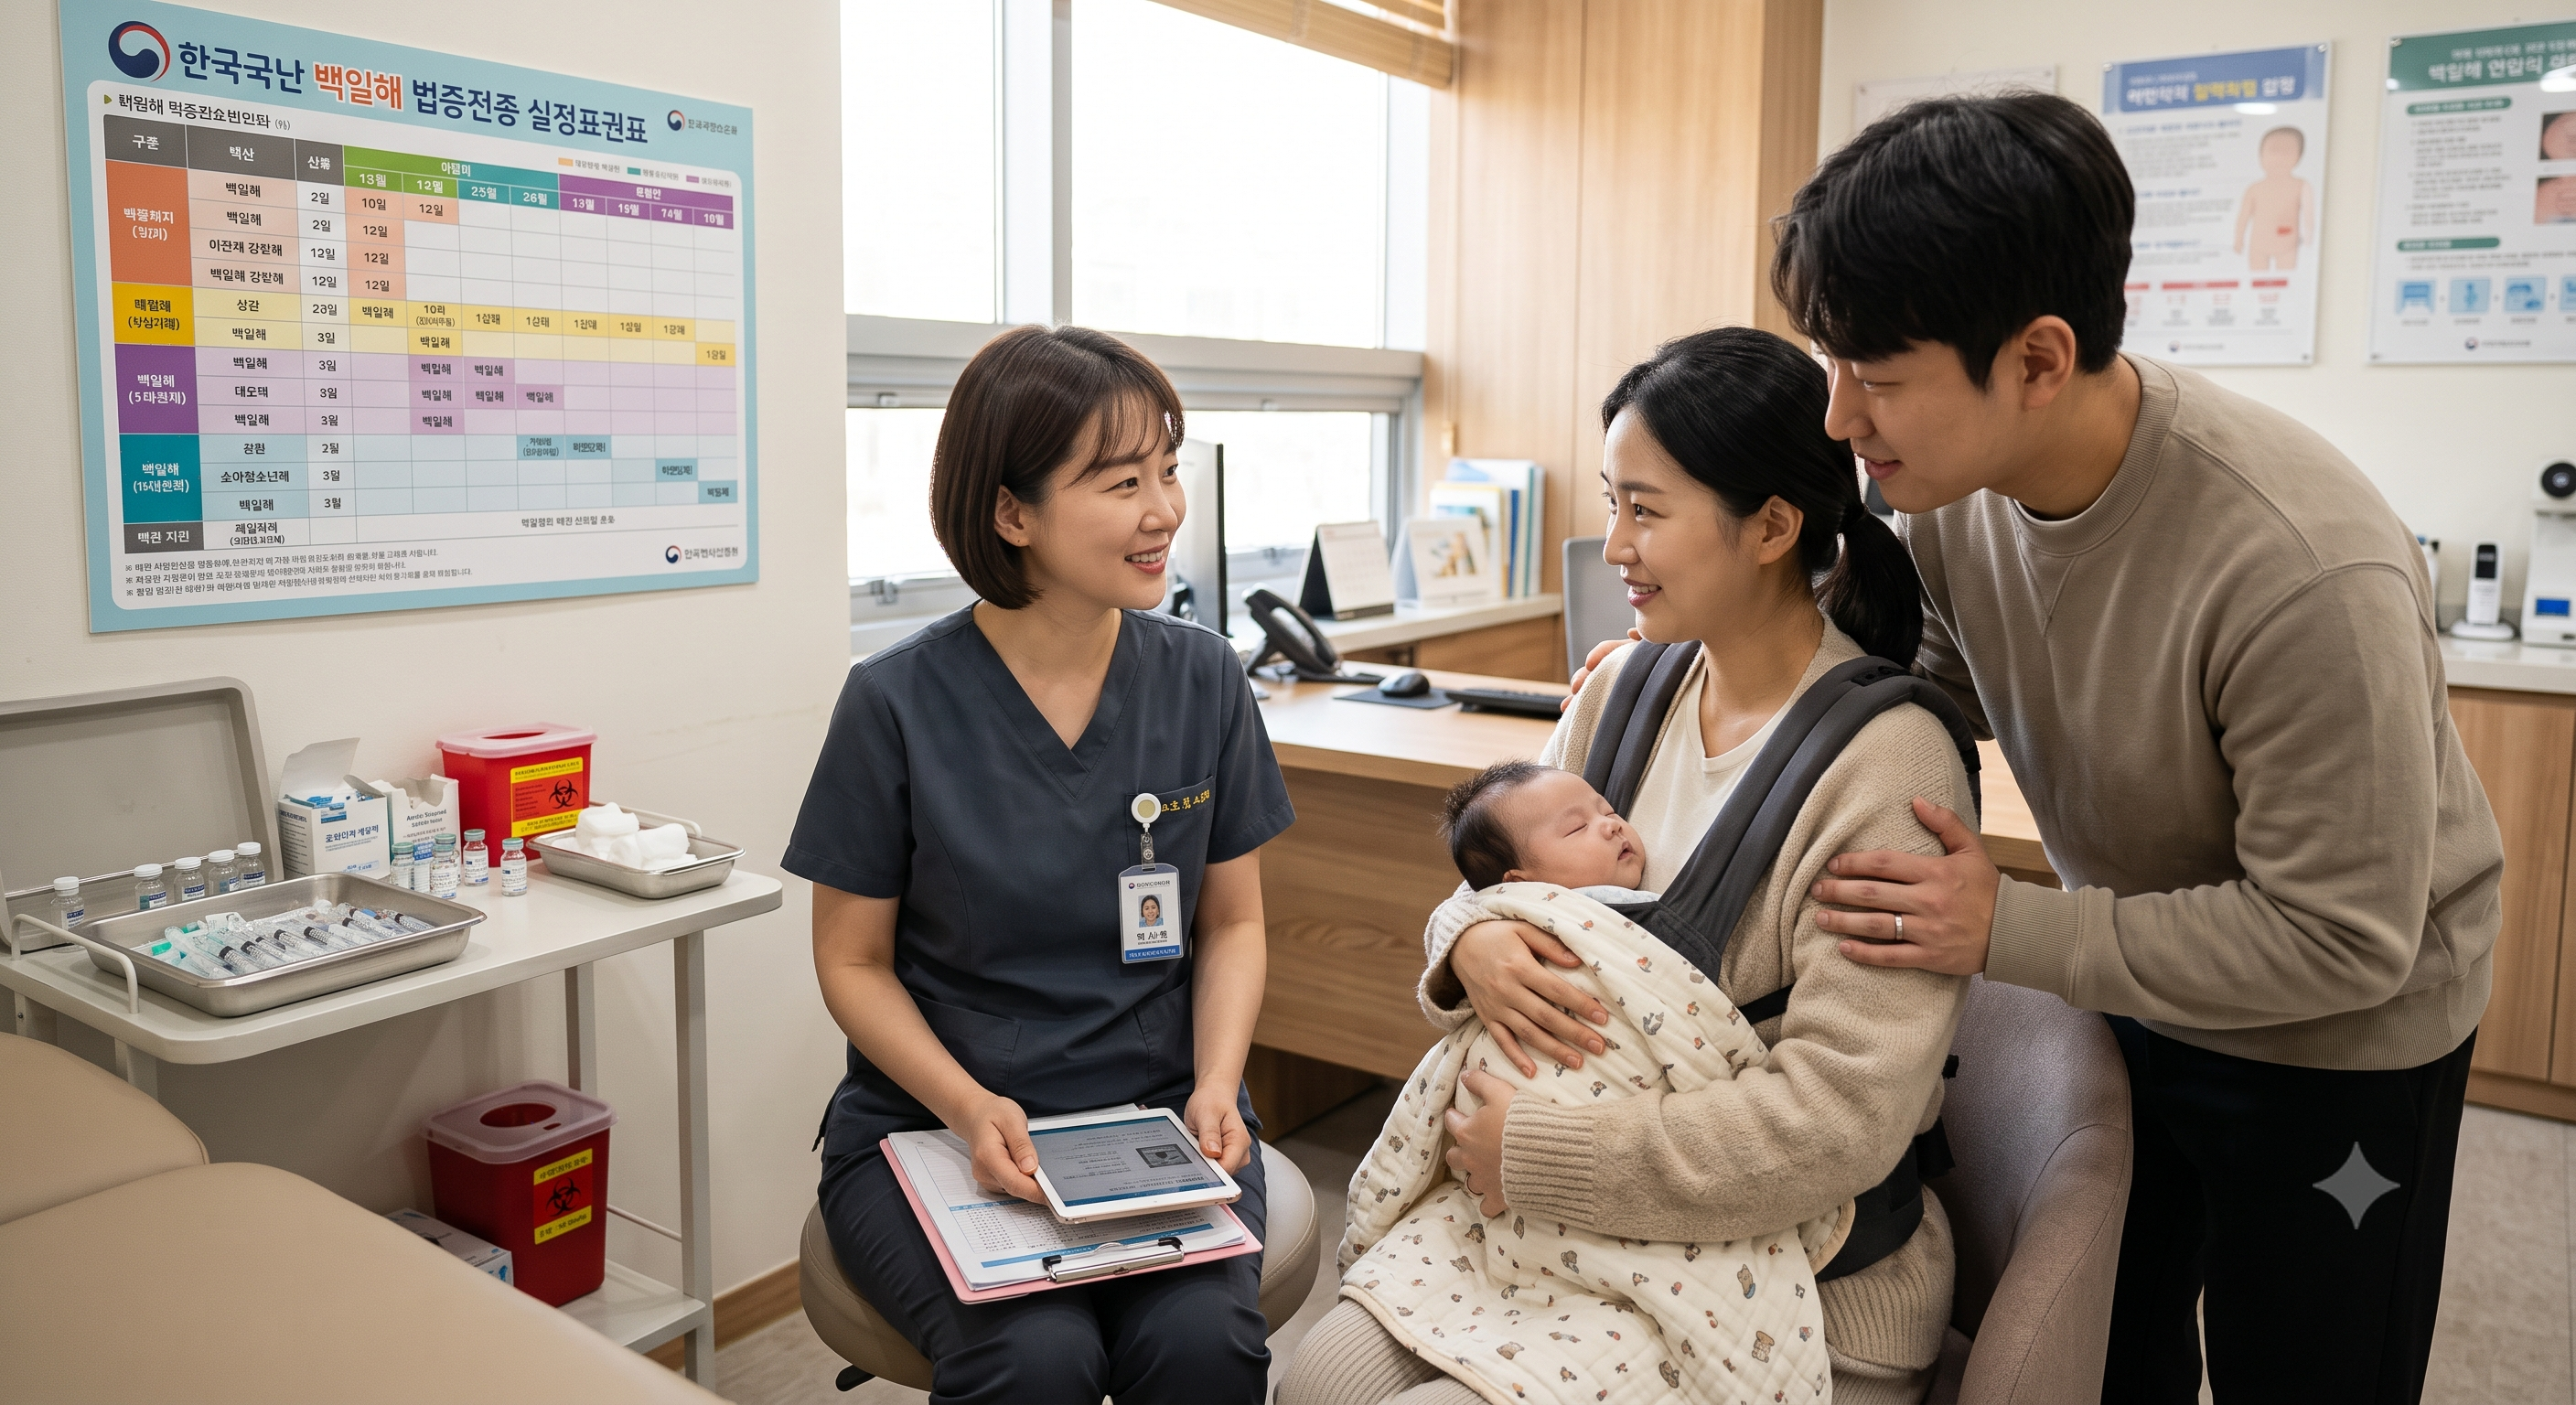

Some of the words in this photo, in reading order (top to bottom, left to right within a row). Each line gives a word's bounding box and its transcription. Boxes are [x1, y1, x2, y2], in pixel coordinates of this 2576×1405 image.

[178, 41, 305, 94] 한국국난
[314, 63, 402, 111] 백일해
[413, 79, 521, 127] 법증전종
[528, 98, 649, 145] 실정표권표
[225, 182, 262, 198] 백일해
[311, 192, 330, 205] 2일
[361, 198, 387, 210] 10일
[419, 203, 444, 217] 12일
[226, 211, 262, 227] 백일해
[312, 220, 331, 232] 2일
[362, 225, 388, 238] 12일
[310, 248, 335, 261] 12일
[364, 252, 389, 265] 12일
[312, 276, 337, 289] 12일
[365, 280, 390, 292] 12일
[317, 332, 336, 345] 3일
